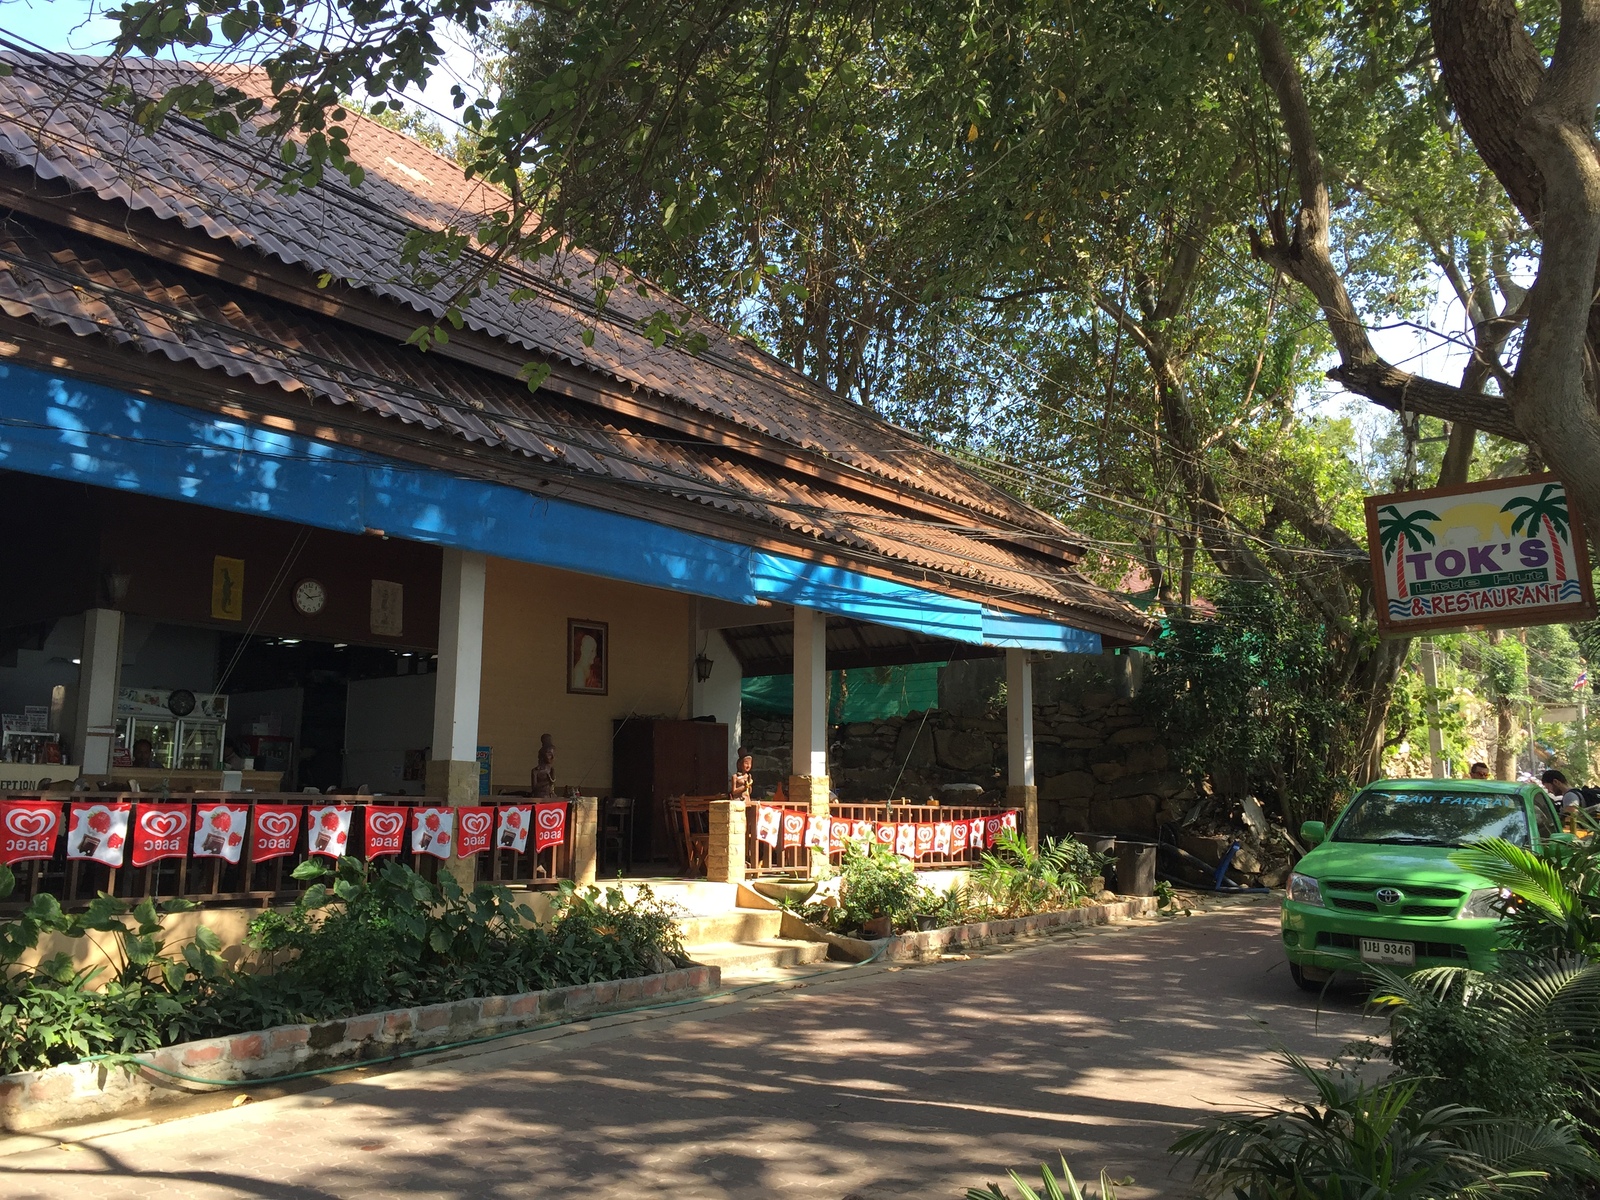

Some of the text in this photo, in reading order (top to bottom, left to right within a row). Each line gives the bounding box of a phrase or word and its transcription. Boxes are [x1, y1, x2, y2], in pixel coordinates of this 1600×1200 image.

[1405, 538, 1549, 580] TOK'S
[1415, 571, 1544, 593] Little Hut
[1410, 583, 1563, 617] & RESTAURANT
[1394, 794, 1434, 804] BAN
[370, 834, 400, 848] วอลล์
[538, 828, 562, 841] วอลล์
[6, 837, 48, 852] วอลล์
[144, 836, 181, 852] วอลล์
[258, 836, 292, 850] วอลล์
[1384, 944, 1411, 956] 9346
